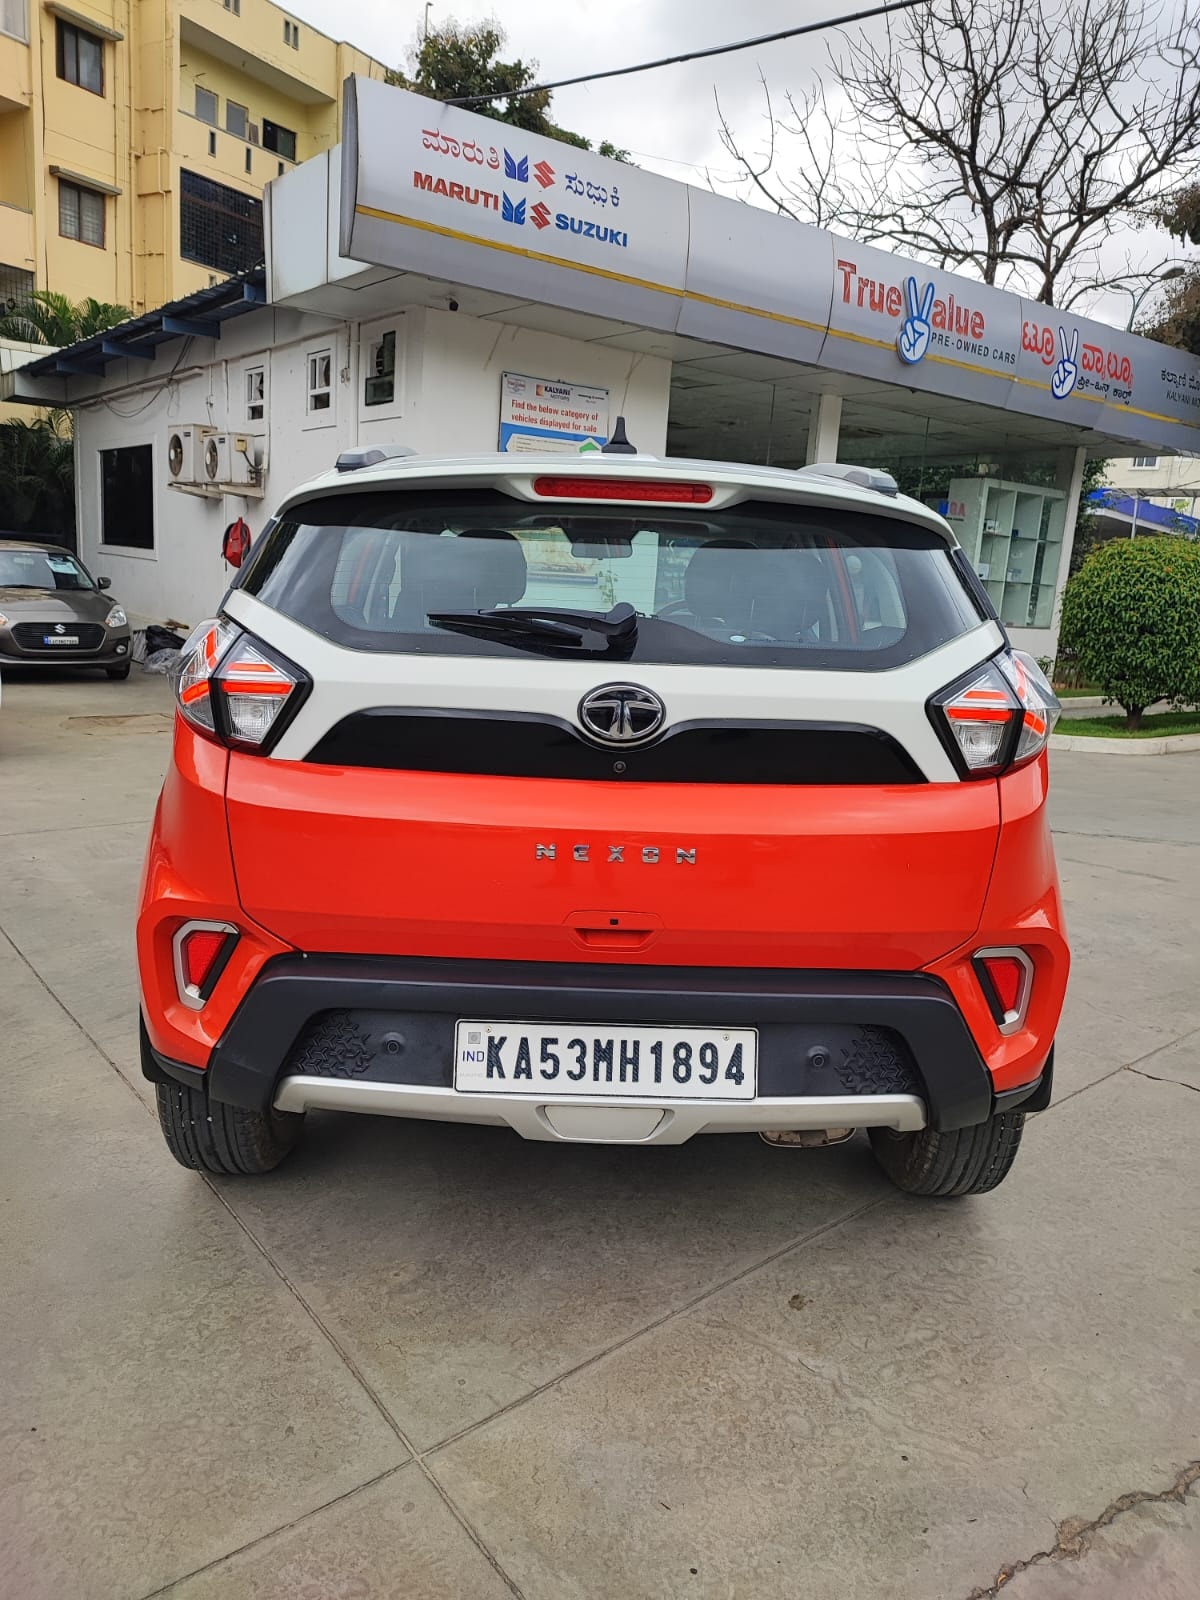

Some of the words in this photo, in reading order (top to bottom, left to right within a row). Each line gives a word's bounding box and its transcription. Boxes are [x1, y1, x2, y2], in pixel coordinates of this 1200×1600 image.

[422, 128, 500, 170] ಮಾರುತಿ
[413, 171, 499, 211] MARUTI
[555, 213, 628, 248] SUZUKI
[837, 259, 902, 318] True
[931, 331, 990, 358] PRE-OWNED
[992, 349, 1016, 365] CARS
[544, 386, 571, 396] KALYANI
[511, 399, 525, 410] Find
[526, 401, 538, 411] the
[538, 404, 559, 415] below
[560, 409, 590, 421] category
[591, 413, 599, 421] of
[511, 413, 538, 424] vehicles
[539, 416, 571, 430] displayed
[572, 421, 582, 431] for
[583, 424, 597, 433] sale
[535, 843, 697, 865] NEXON
[462, 1050, 485, 1063] IND
[486, 1035, 745, 1086] KA53MH1894
